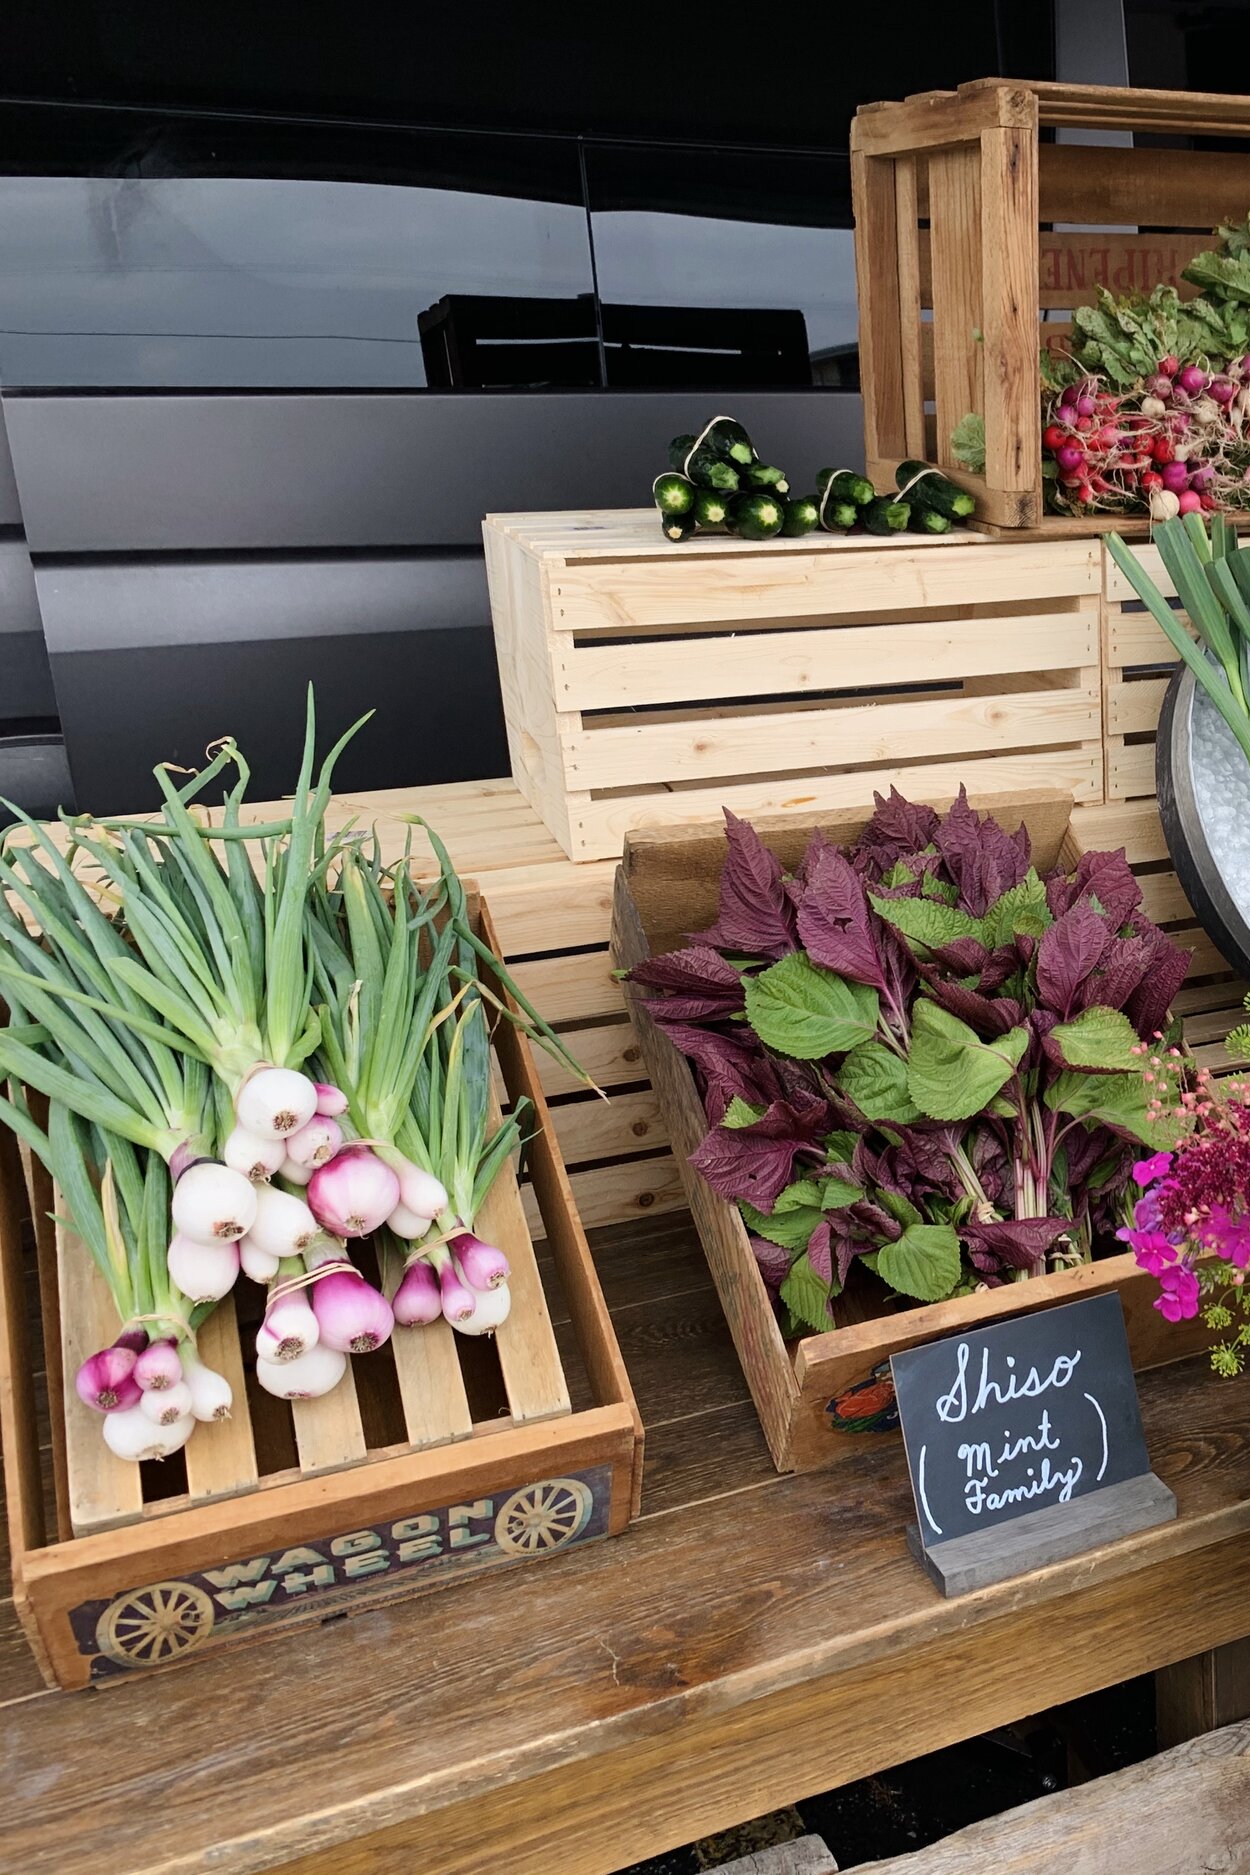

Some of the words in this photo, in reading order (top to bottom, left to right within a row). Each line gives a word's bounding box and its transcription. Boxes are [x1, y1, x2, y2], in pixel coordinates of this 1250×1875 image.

[936, 1343, 1081, 1423] Shiso
[202, 1499, 493, 1588] WAGON
[213, 1527, 491, 1610] WHEEL
